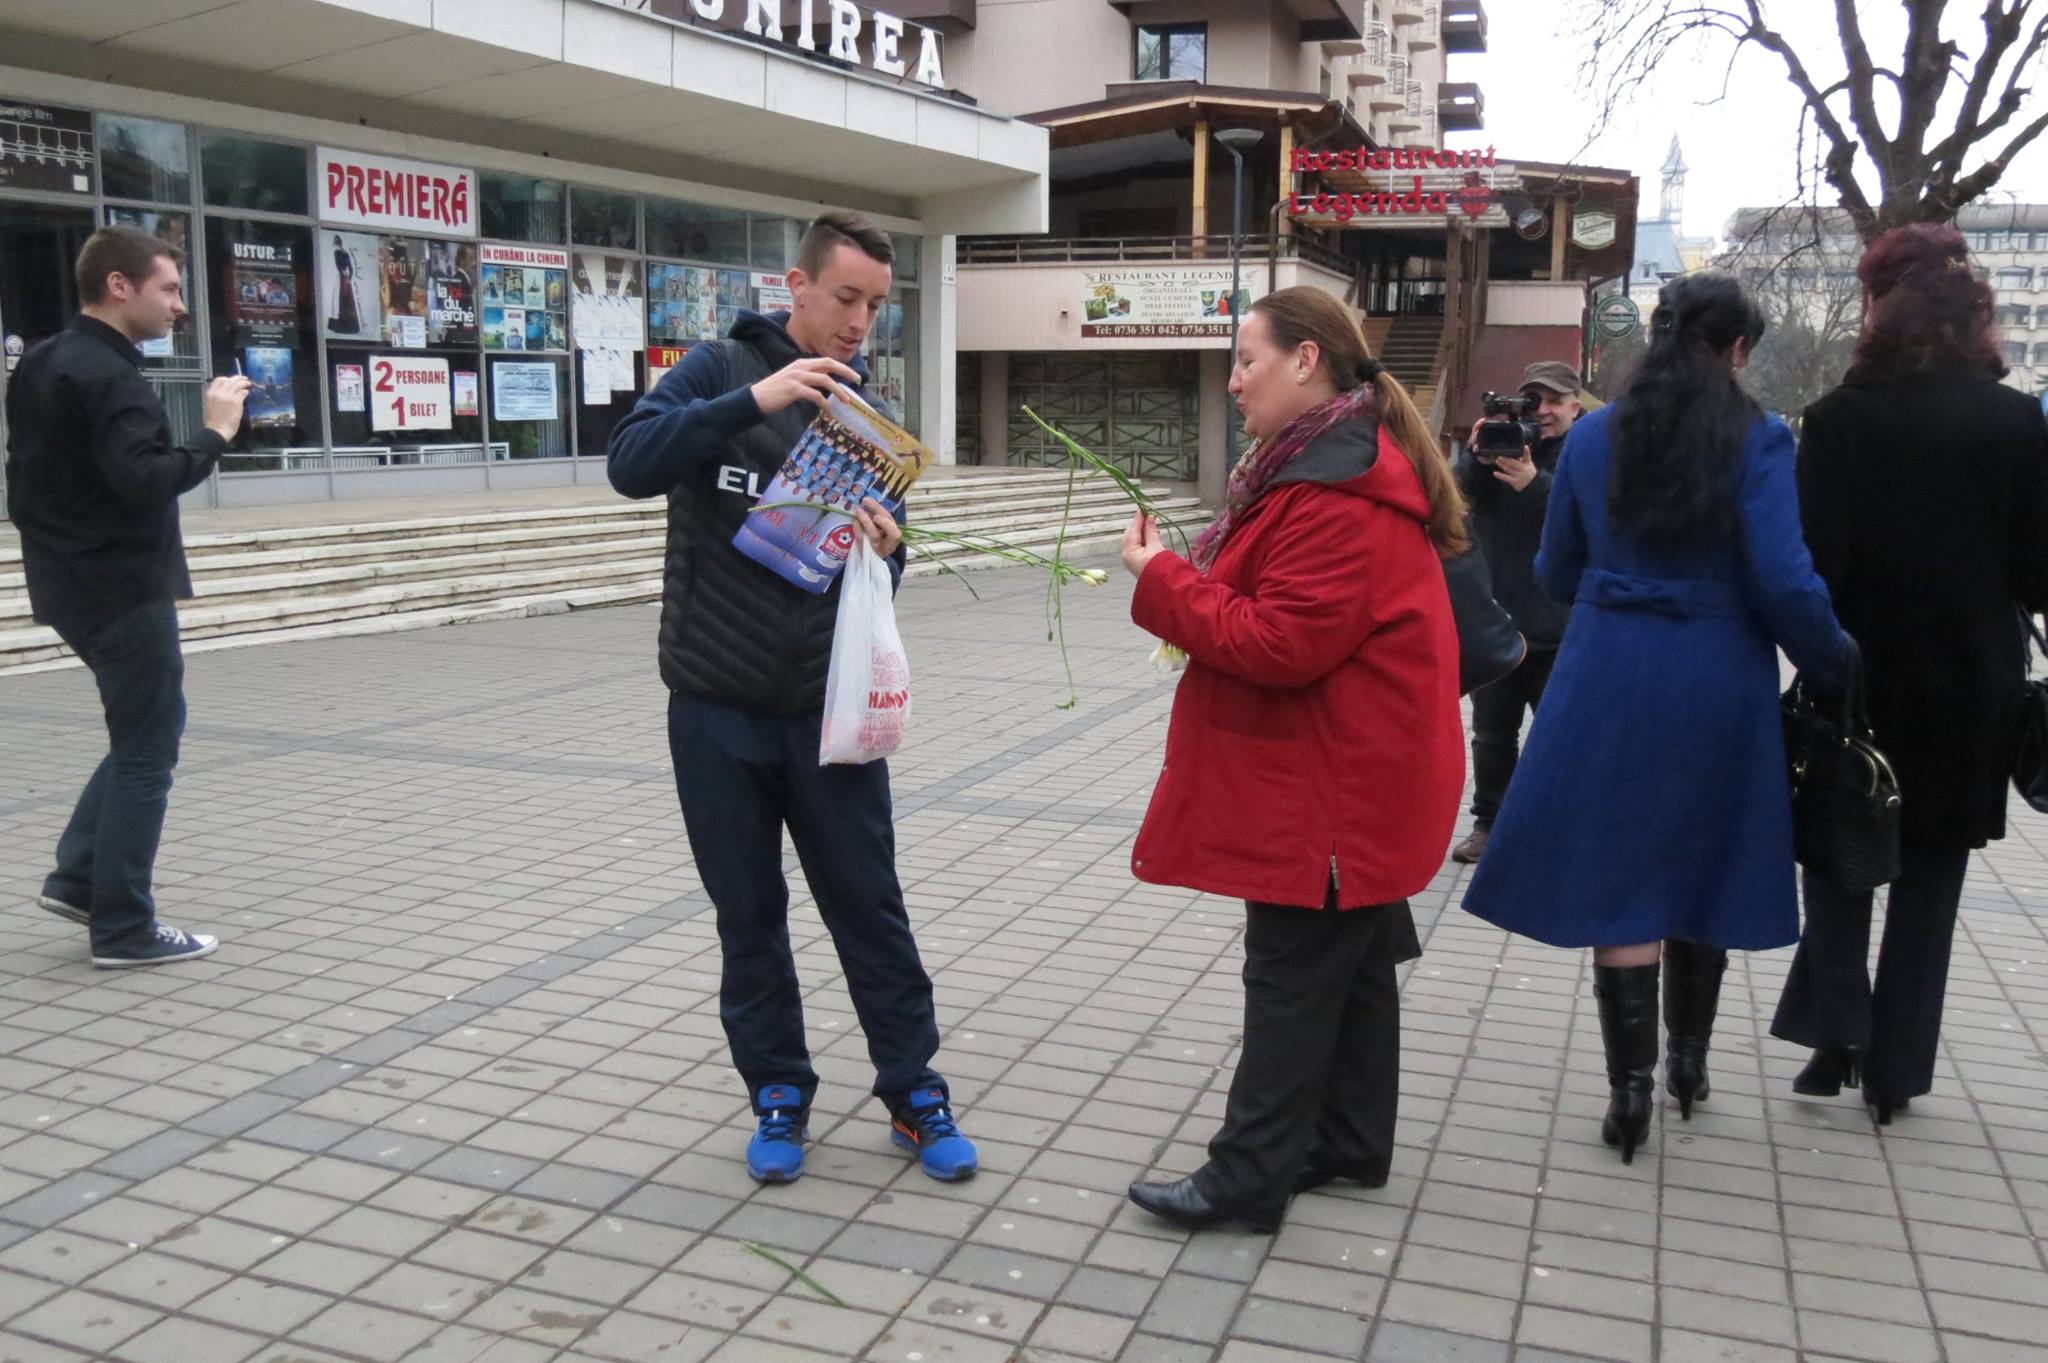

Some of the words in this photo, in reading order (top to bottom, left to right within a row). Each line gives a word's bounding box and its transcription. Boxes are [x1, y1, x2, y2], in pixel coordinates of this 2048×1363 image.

[1288, 143, 1497, 173] Restaurant
[1288, 175, 1448, 222] Legenda
[233, 242, 292, 261] USTURi
[526, 251, 536, 264] LA
[537, 252, 565, 266] CINEMA
[380, 261, 426, 277] YOUTH
[1099, 271, 1176, 283] RESTAURANT
[1183, 270, 1235, 280] LEGEND
[437, 282, 448, 298] la
[444, 296, 459, 310] du
[430, 306, 475, 322] marché
[1094, 325, 1112, 335] Tel:
[1115, 325, 1137, 335] 0736
[1139, 325, 1155, 335] 351
[1181, 325, 1205, 335] 0736
[1207, 325, 1223, 335] 351
[374, 360, 395, 393] 2
[396, 369, 446, 385] PERSOANE
[391, 396, 406, 427] 1
[410, 402, 438, 417] BILET
[718, 464, 763, 498] EL
